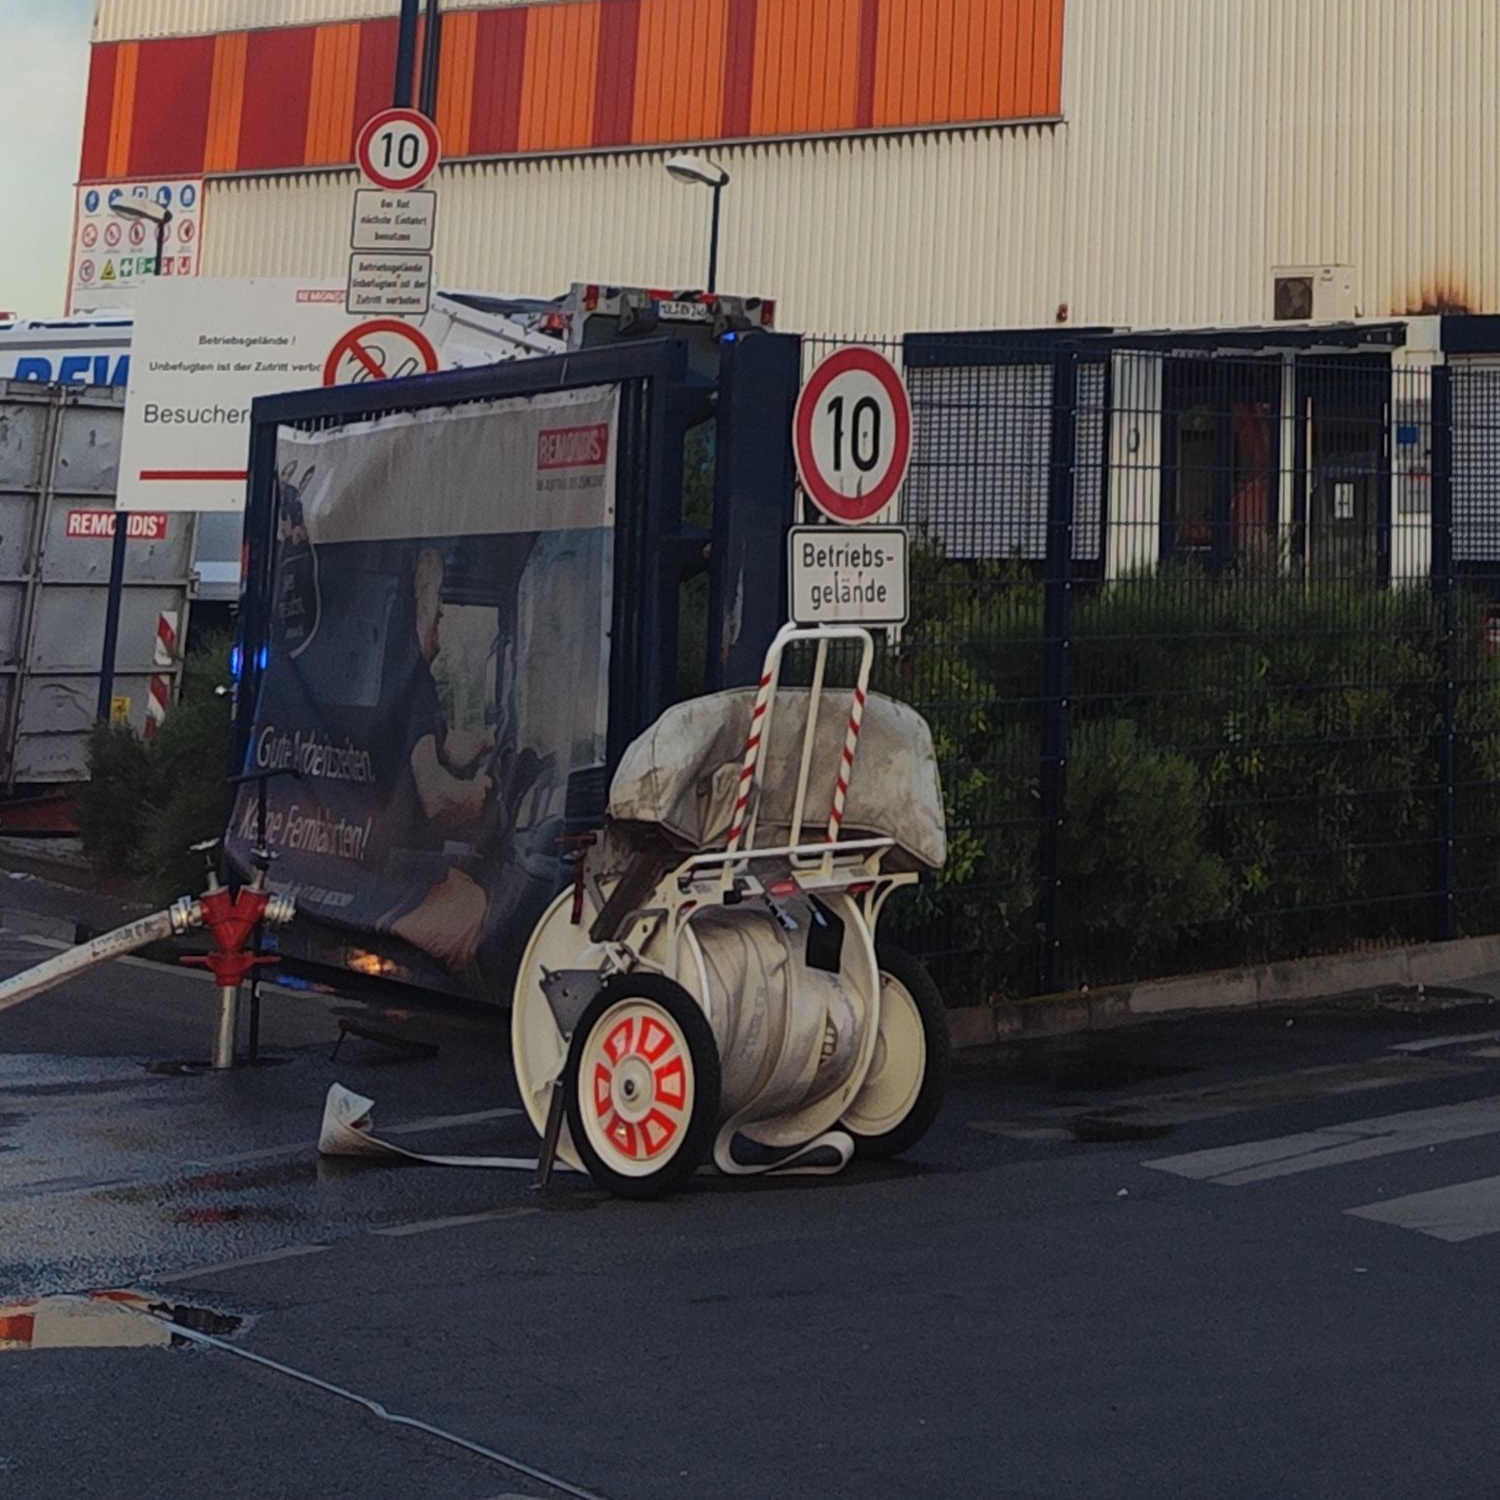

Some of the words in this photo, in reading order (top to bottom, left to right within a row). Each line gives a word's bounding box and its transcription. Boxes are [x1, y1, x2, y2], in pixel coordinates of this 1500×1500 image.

[381, 132, 420, 169] 10
[359, 261, 422, 274] Betriebsgelände
[352, 278, 397, 291] Unbefugten
[386, 296, 421, 305] verboten
[199, 335, 289, 348] Betriebsgelände
[149, 361, 214, 374] Unbefugten
[217, 362, 231, 372] ist
[233, 362, 251, 372] der
[254, 361, 289, 372] Zutritt
[292, 362, 322, 372] verbo
[143, 403, 251, 424] Besucher
[827, 395, 881, 472] 10
[69, 513, 157, 535] REMODIS
[802, 541, 895, 569] Betriebs-
[811, 577, 887, 611] gelände
[256, 726, 292, 769] Gute
[238, 798, 283, 844] Kene
